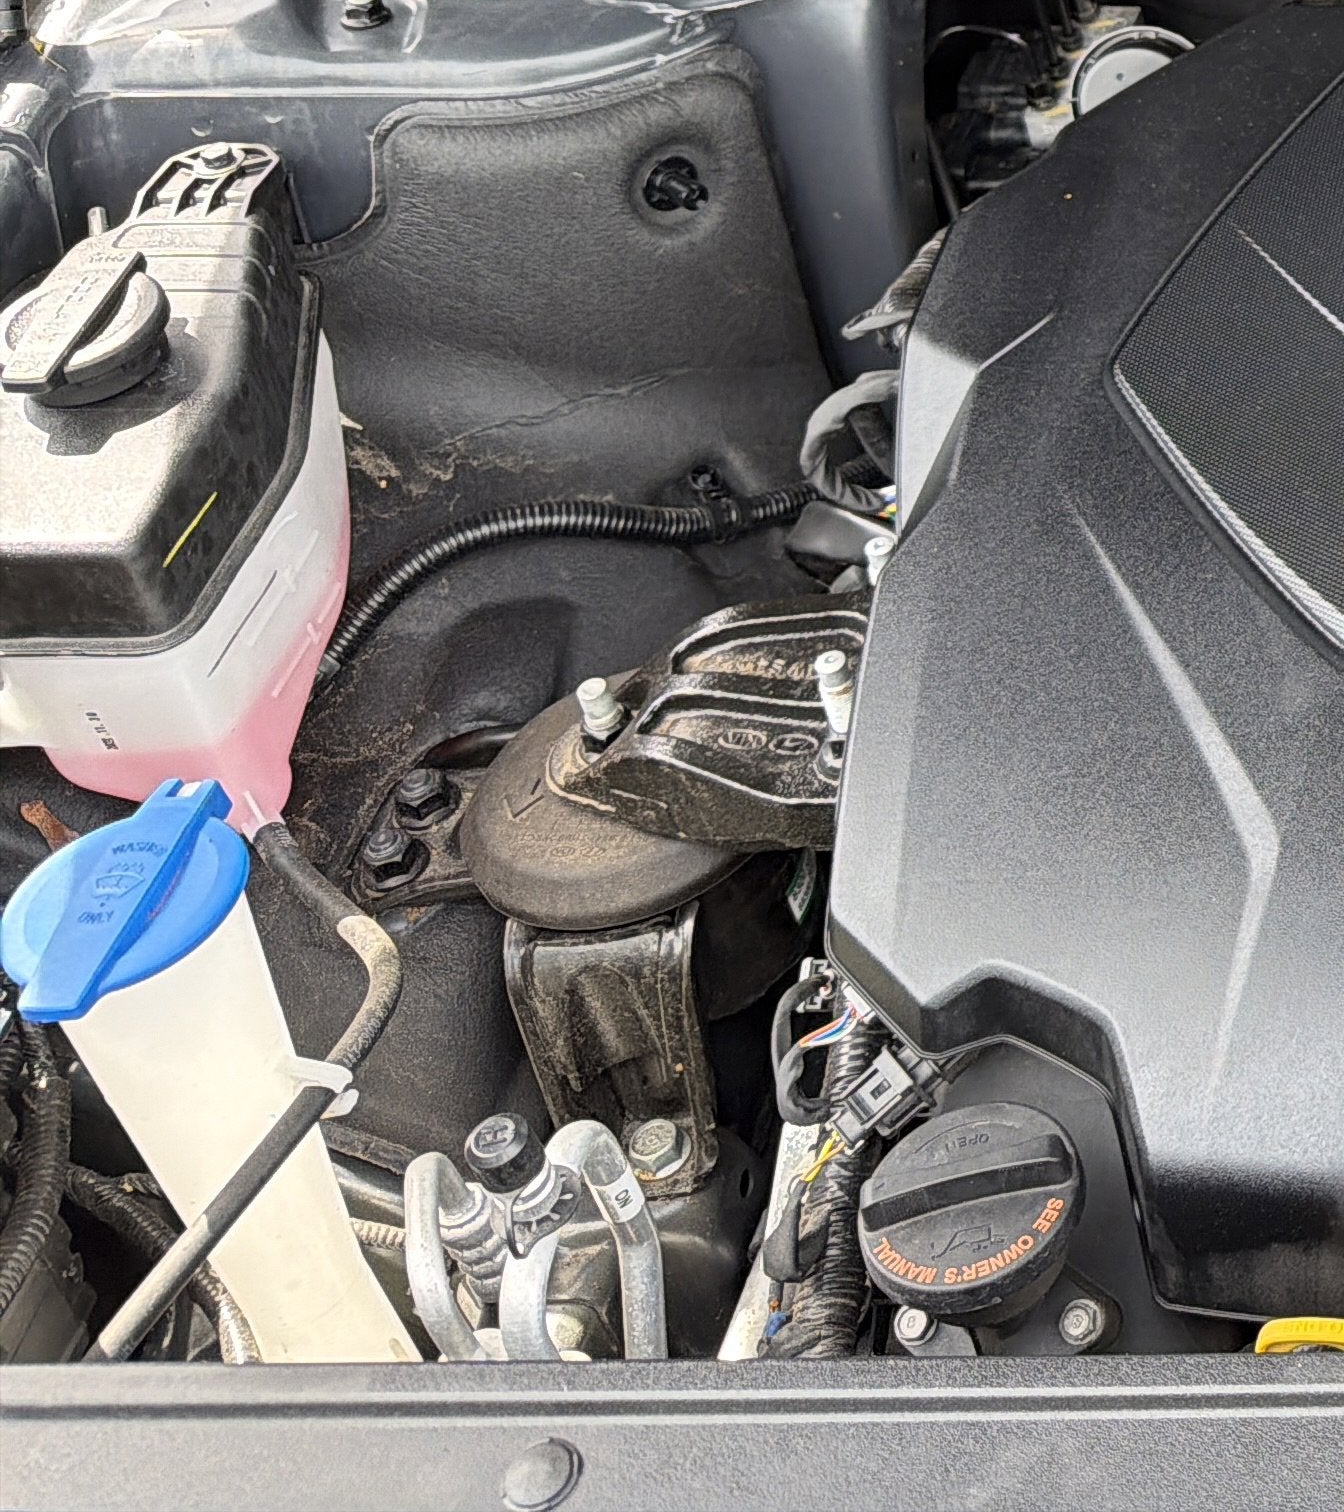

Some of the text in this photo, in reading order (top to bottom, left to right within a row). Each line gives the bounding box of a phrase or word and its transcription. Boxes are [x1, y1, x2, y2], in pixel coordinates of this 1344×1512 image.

[872, 1196, 1065, 1285] SEE OWNER'S MANUAL
